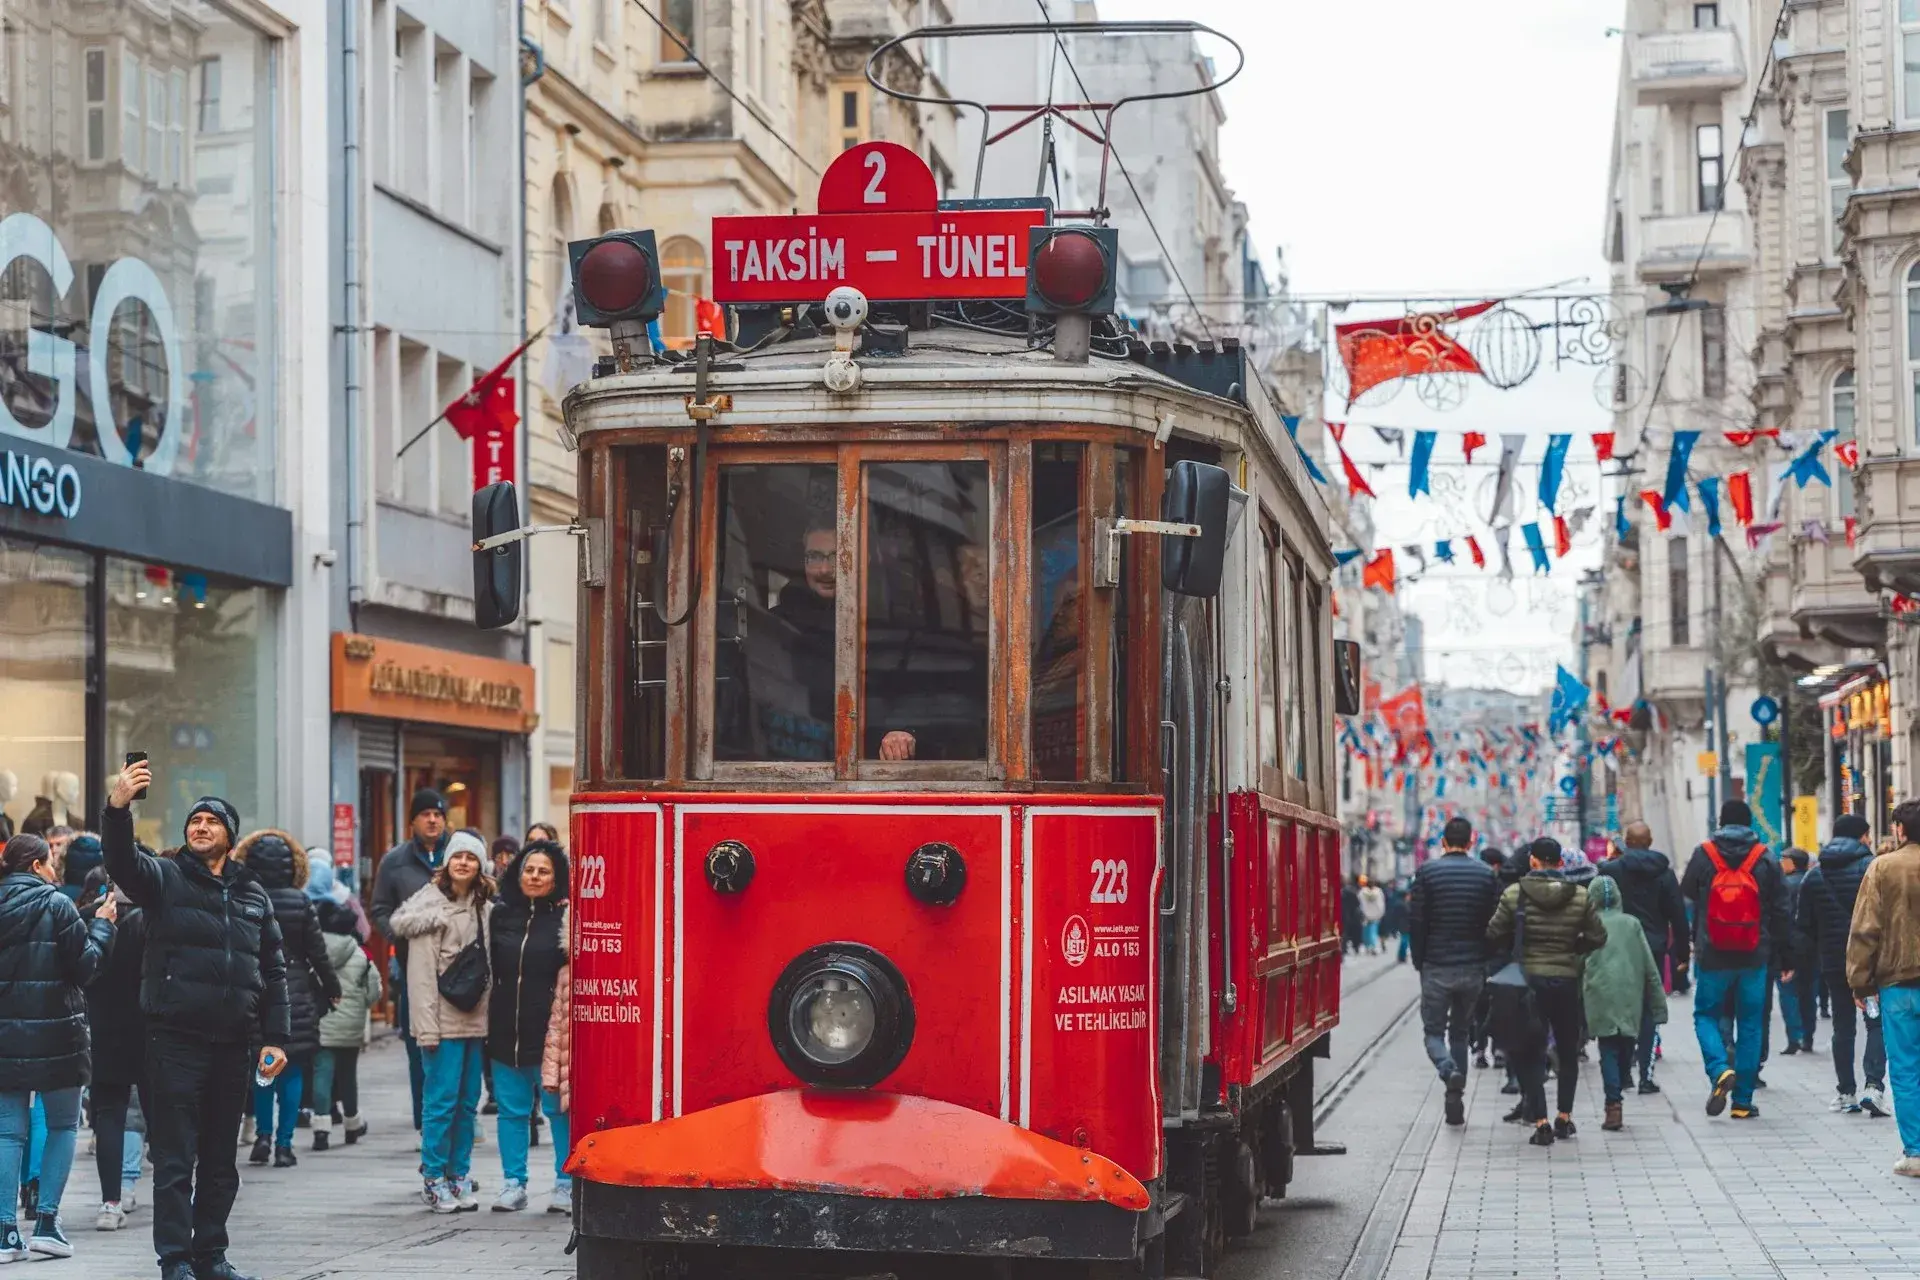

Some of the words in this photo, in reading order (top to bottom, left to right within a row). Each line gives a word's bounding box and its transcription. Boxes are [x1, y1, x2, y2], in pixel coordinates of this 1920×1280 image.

[864, 151, 886, 203] 2
[724, 226, 845, 282] TAKSİM
[917, 223, 1026, 278] TÜNEL
[580, 855, 606, 899] 223
[1090, 858, 1128, 904] 223
[1093, 925, 1140, 934] www.iett.gov.tr
[582, 937, 599, 953] ALO
[600, 938, 622, 954] 153
[1093, 942, 1121, 957] ALO
[1122, 942, 1140, 957] 153
[600, 978, 639, 997] YASAK
[1057, 985, 1117, 1004] ASILMAK
[1118, 984, 1145, 1003] YASAK
[577, 1001, 641, 1024] TEHLİKELİDİR
[1054, 1013, 1074, 1032] VE
[1075, 1007, 1147, 1031] TEHLİKELİDİR
